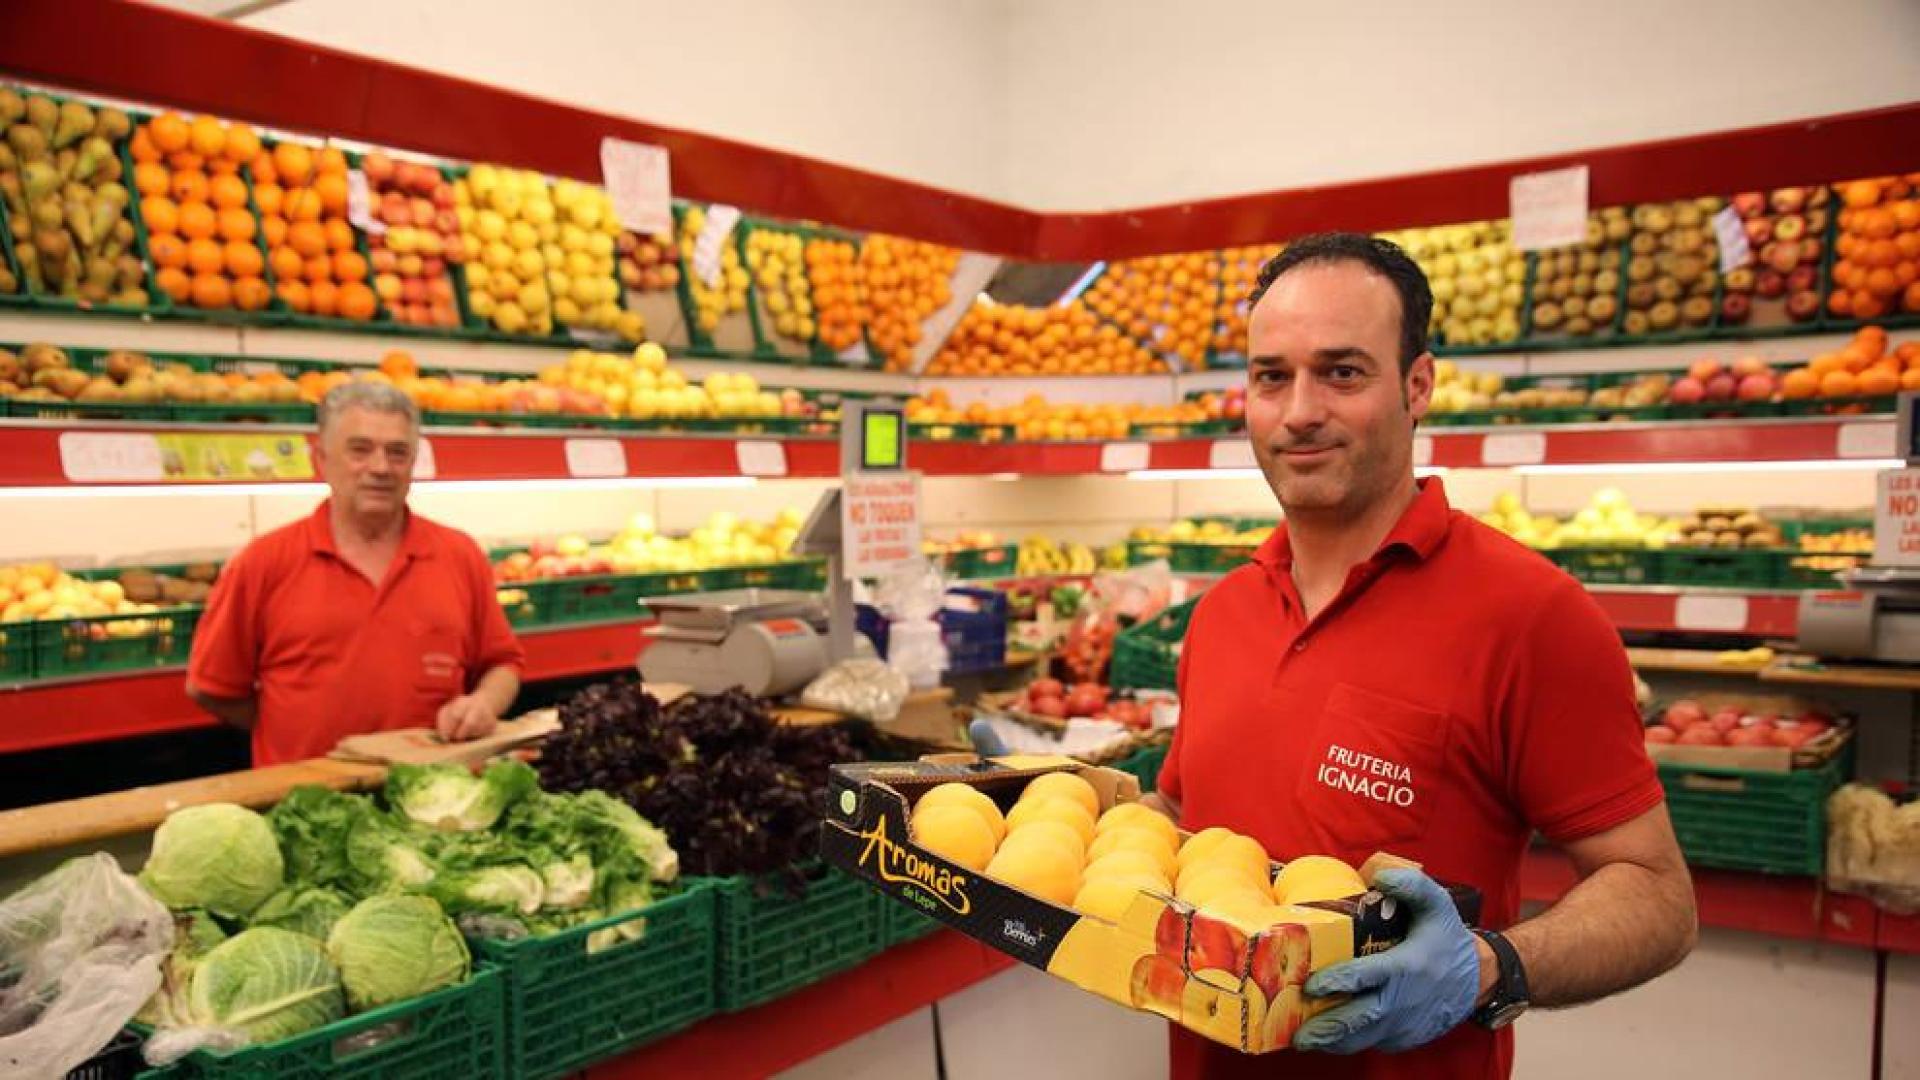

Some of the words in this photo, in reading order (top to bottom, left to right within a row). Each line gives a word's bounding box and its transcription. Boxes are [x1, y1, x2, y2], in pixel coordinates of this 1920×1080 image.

[1889, 495, 1917, 516] NO
[1327, 744, 1412, 783] FRUTERIA
[1318, 763, 1415, 807] IGNACIO
[858, 813, 971, 916] Aromas
